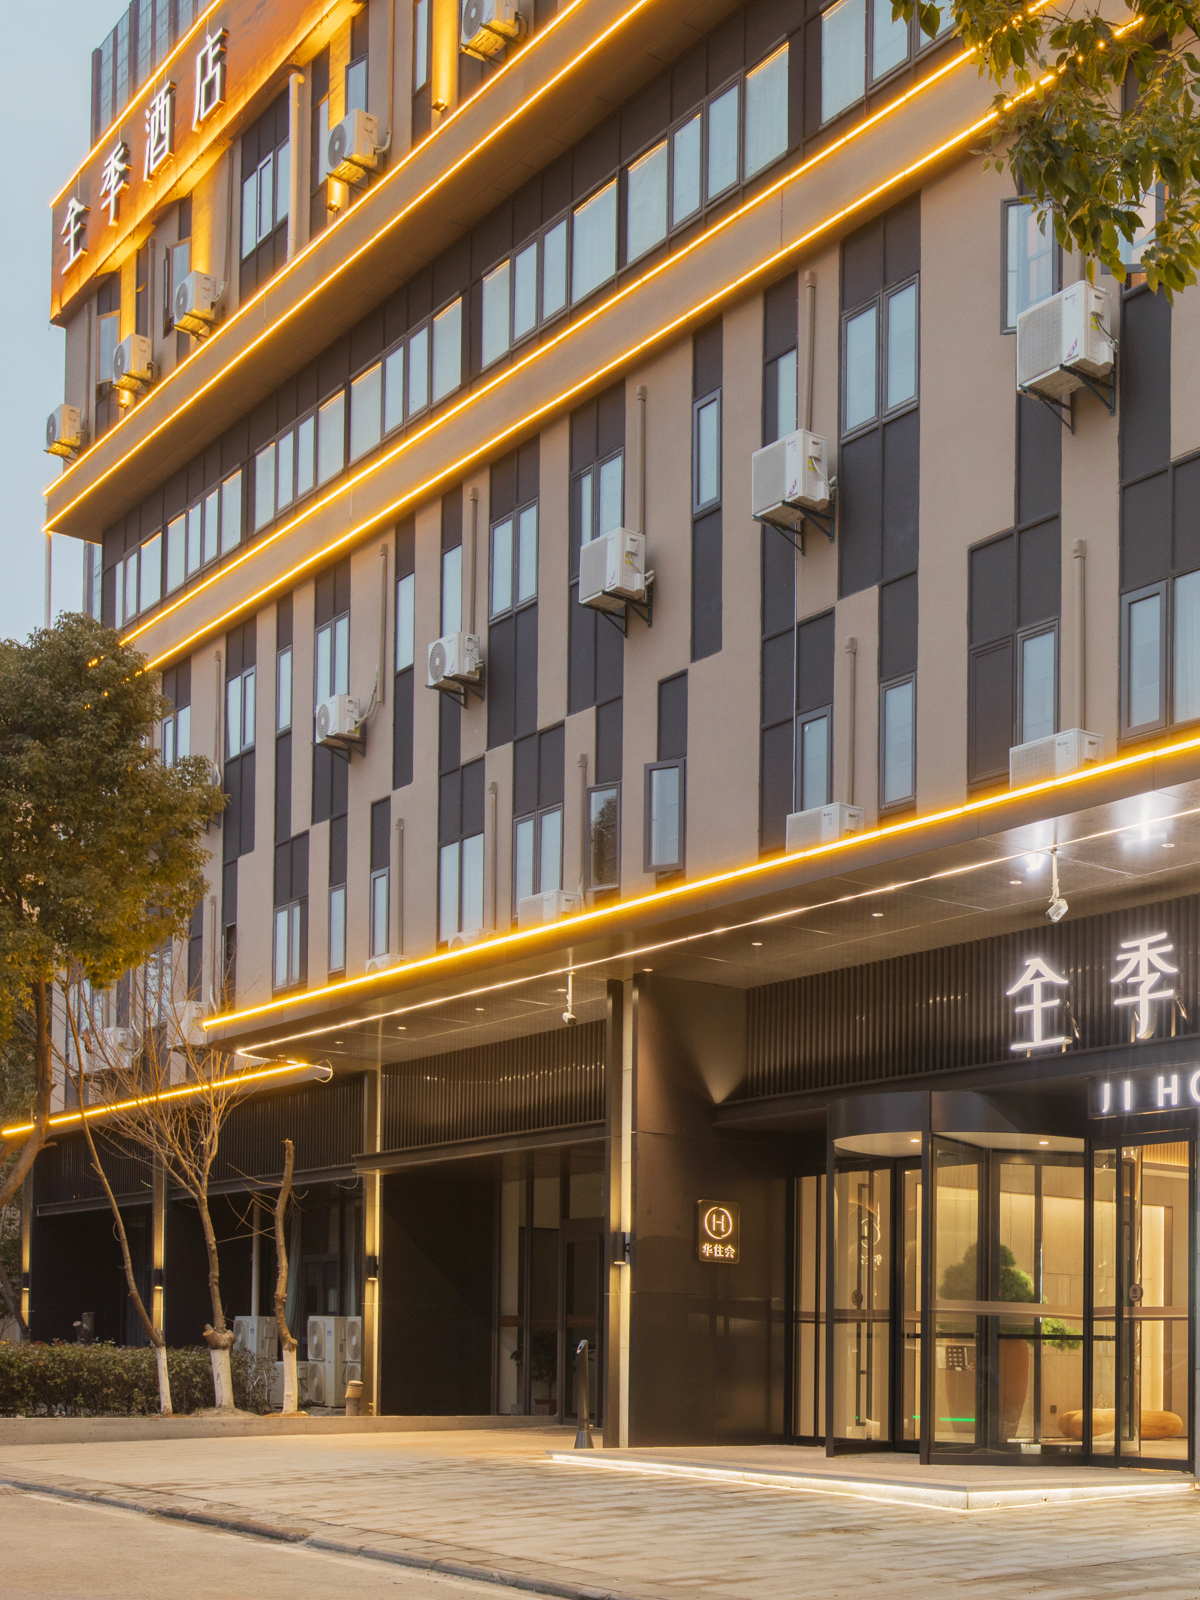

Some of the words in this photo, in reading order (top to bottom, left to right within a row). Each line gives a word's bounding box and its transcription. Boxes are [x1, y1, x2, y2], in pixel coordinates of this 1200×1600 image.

[60, 27, 227, 276] 全季酒店
[1102, 1080, 1131, 1113] JI
[702, 1243, 736, 1258] 华住会
